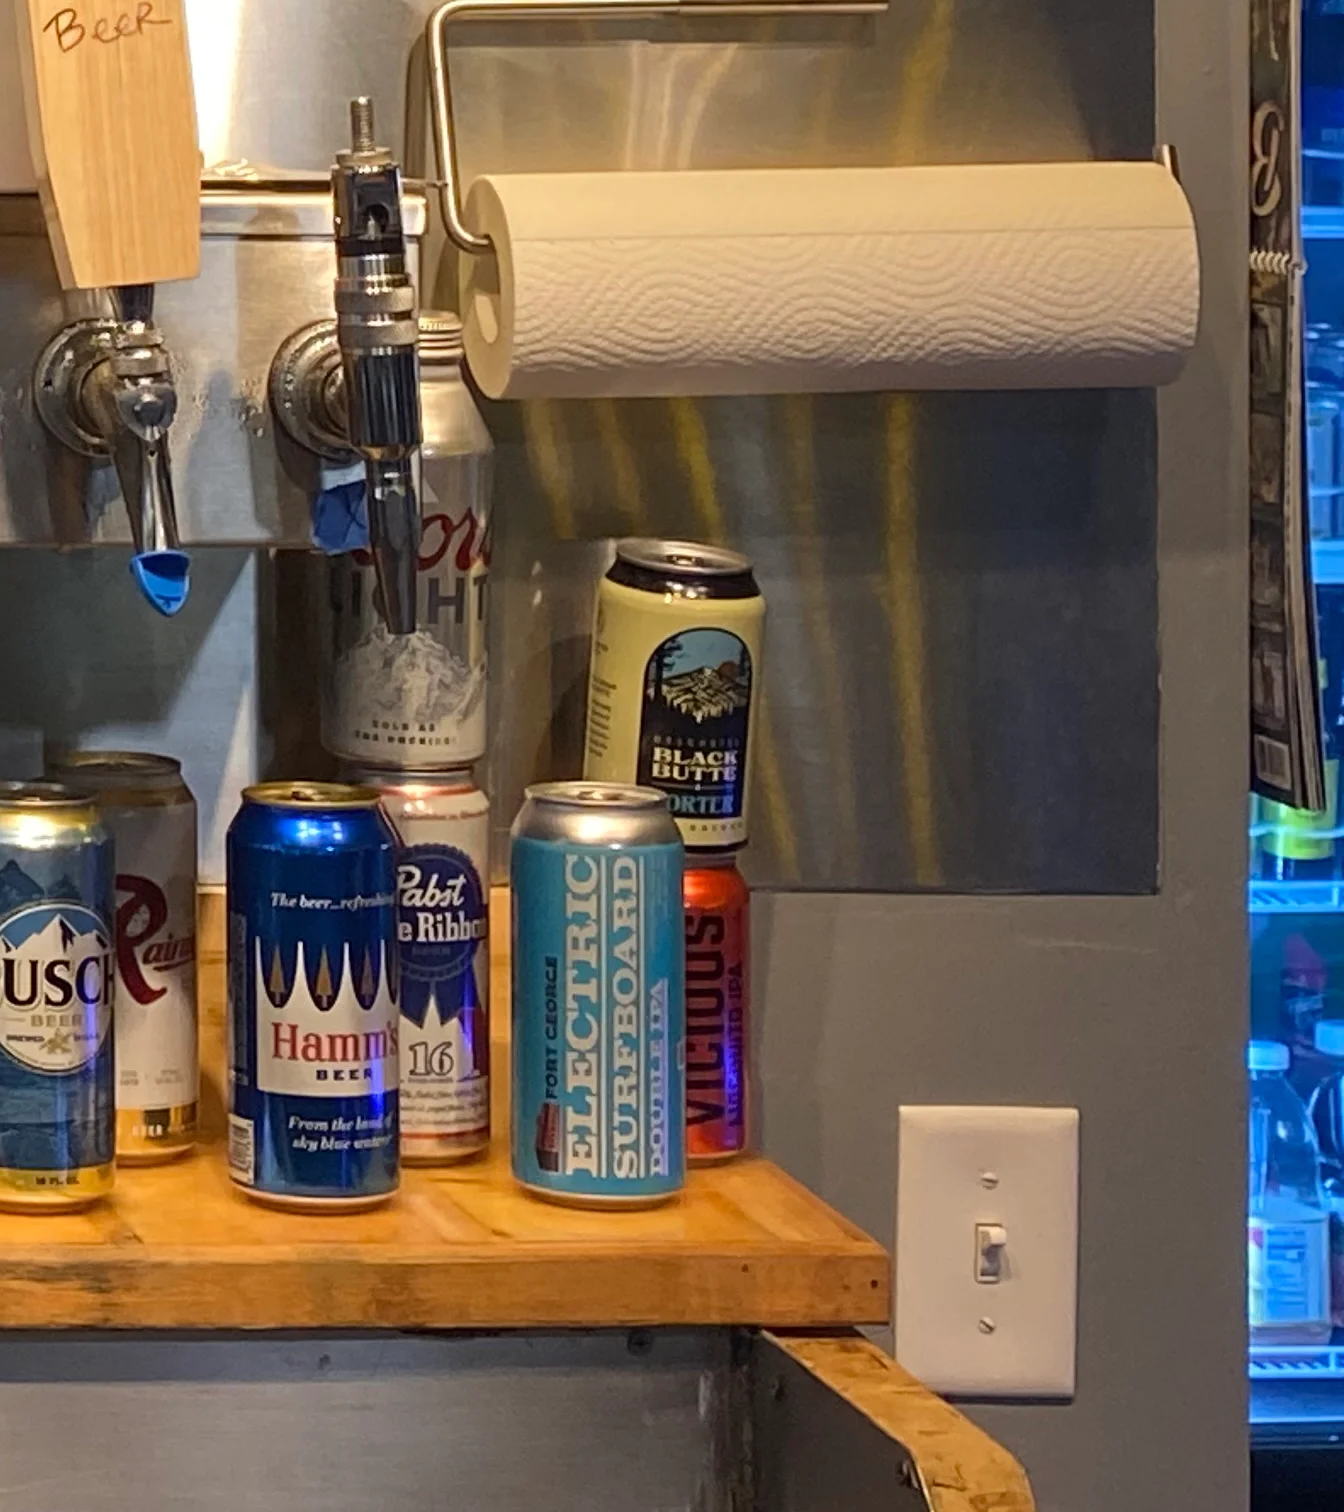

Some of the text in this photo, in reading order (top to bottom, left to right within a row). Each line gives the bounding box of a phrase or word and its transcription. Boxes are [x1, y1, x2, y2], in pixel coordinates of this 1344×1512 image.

[652, 746, 739, 766] BLACK
[650, 762, 736, 783] BUTTE
[666, 792, 734, 815] ORTER
[270, 891, 297, 908] The
[396, 864, 466, 909] Pabst
[31, 1013, 84, 1028] BEER
[544, 955, 559, 1100] FORT GEORGE
[565, 853, 600, 1177] ELECTRIC
[612, 855, 639, 1179] SURFBOARD
[684, 915, 726, 1128] VICIOUS
[270, 1018, 399, 1065] Hamm's
[409, 1040, 455, 1077] 16
[315, 1068, 373, 1082] BEER
[648, 978, 670, 1177] DOUBLE IPA
[287, 1115, 329, 1132] From
[330, 1114, 353, 1131] the
[320, 1135, 352, 1151] blue
